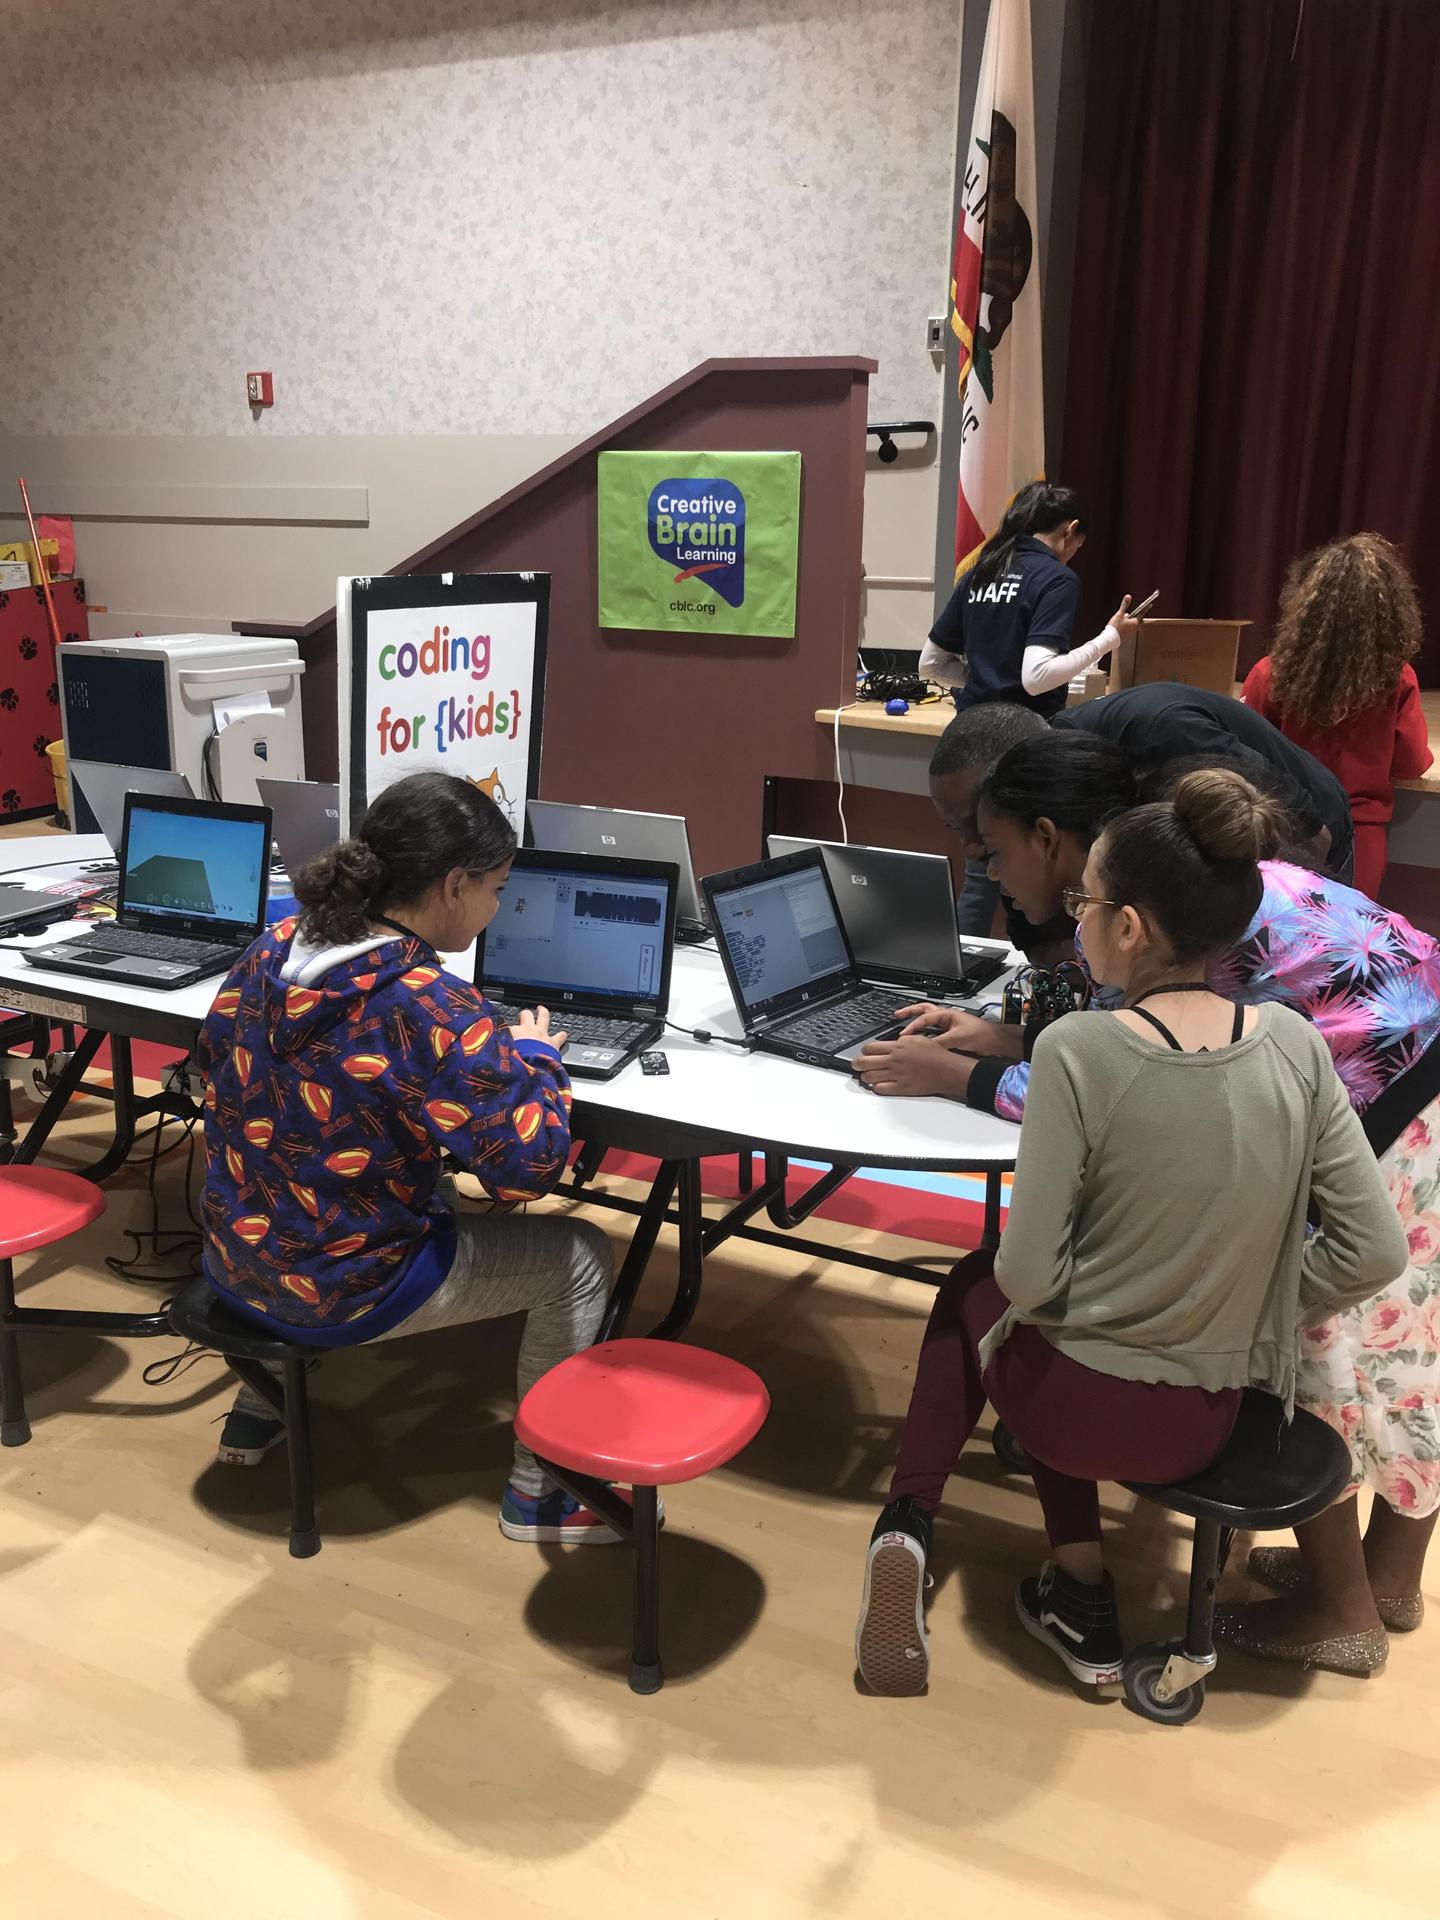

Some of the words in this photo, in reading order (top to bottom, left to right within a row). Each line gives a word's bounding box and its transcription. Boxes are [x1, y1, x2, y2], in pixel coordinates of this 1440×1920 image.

[657, 494, 737, 514] Creative
[656, 513, 737, 547] Brain
[676, 546, 737, 565] Learning
[669, 600, 716, 615] cblc.org
[378, 625, 491, 681] coding
[376, 706, 426, 756] for
[434, 689, 522, 753] {kids}
